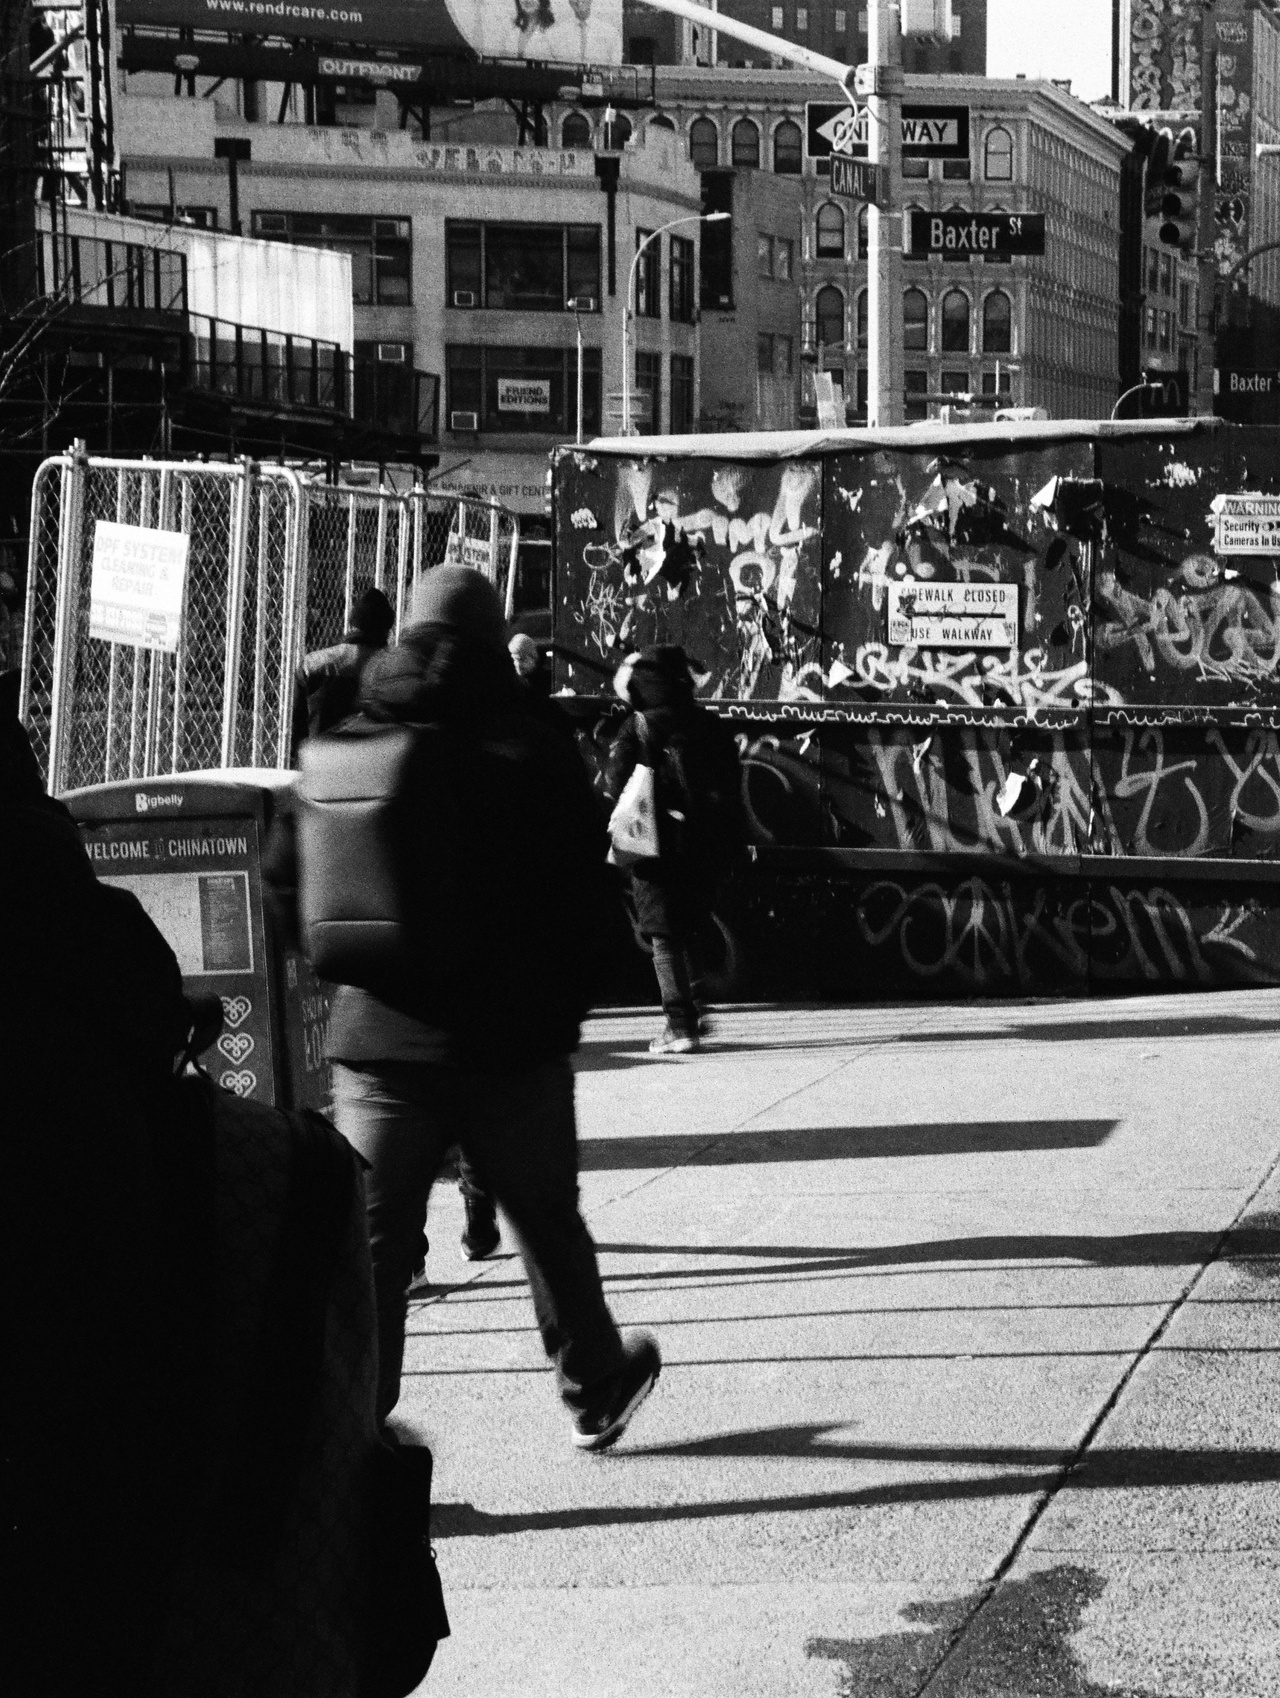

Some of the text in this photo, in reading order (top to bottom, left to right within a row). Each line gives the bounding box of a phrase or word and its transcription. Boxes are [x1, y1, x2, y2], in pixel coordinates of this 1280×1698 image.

[207, 0, 362, 22] www.rendrcare.com
[902, 121, 948, 142] WAY
[833, 160, 866, 197] CANAL
[931, 217, 1022, 249] Baxter St
[1230, 372, 1272, 392] Baxter
[500, 485, 519, 496] GIFT
[522, 485, 548, 497] CENT
[1224, 520, 1260, 533] Security
[1224, 534, 1259, 546] Cameras
[1261, 534, 1269, 546] In
[901, 588, 1006, 603] SIDEWALK CLOSED
[912, 627, 930, 639] USE
[942, 628, 993, 640] WALKWAY
[135, 793, 183, 812] Bigbelly
[168, 837, 248, 857] CHINATOWN
